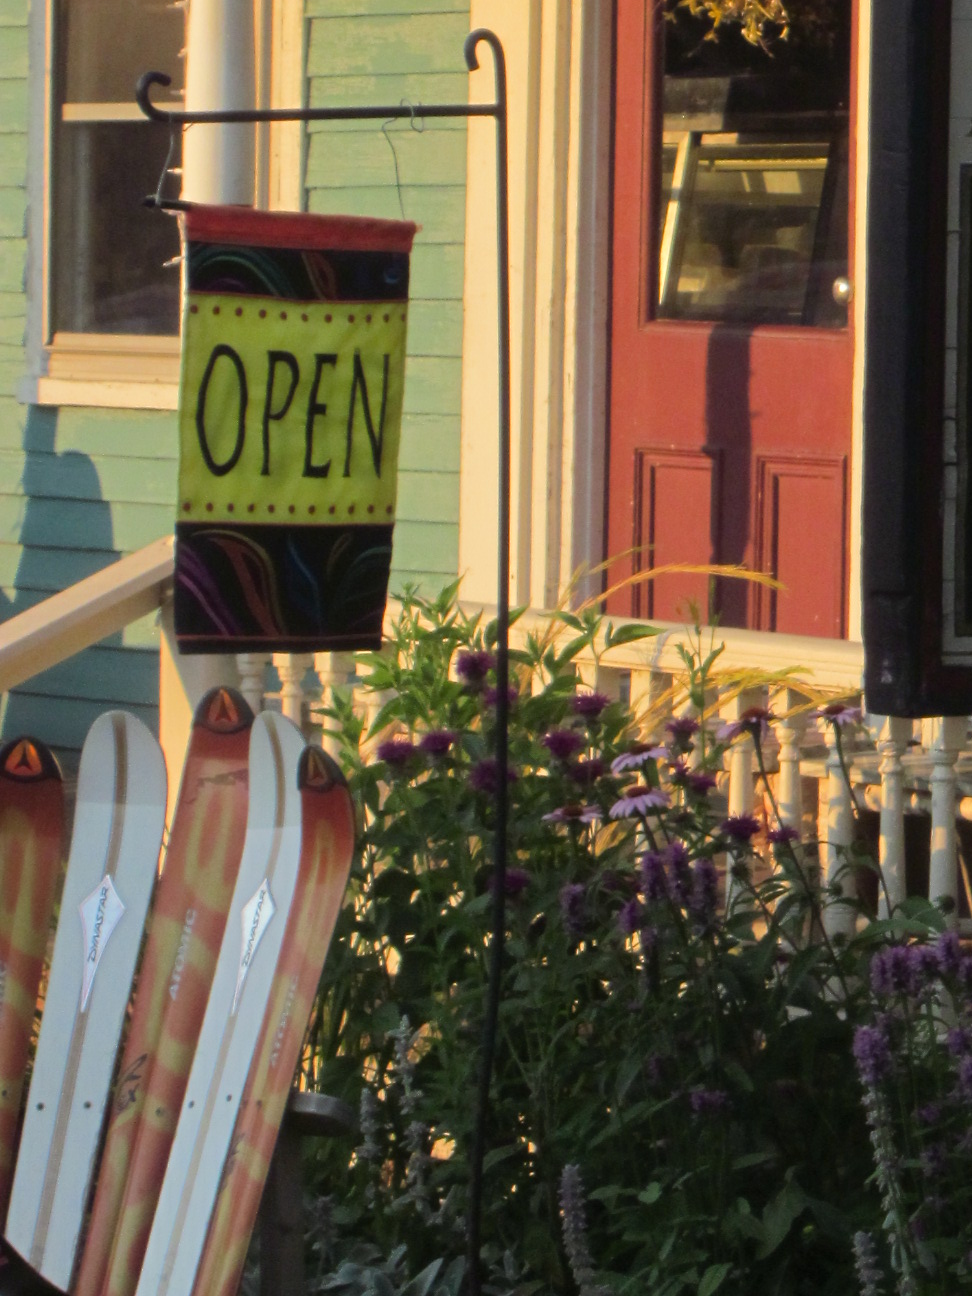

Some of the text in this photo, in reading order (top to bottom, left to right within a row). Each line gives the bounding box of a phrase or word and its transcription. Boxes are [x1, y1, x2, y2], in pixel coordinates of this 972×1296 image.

[195, 343, 390, 479] OPEN
[87, 886, 109, 962] DYNASTAR
[169, 908, 197, 1001] ATOMIC
[241, 889, 266, 967] DYNASTAR
